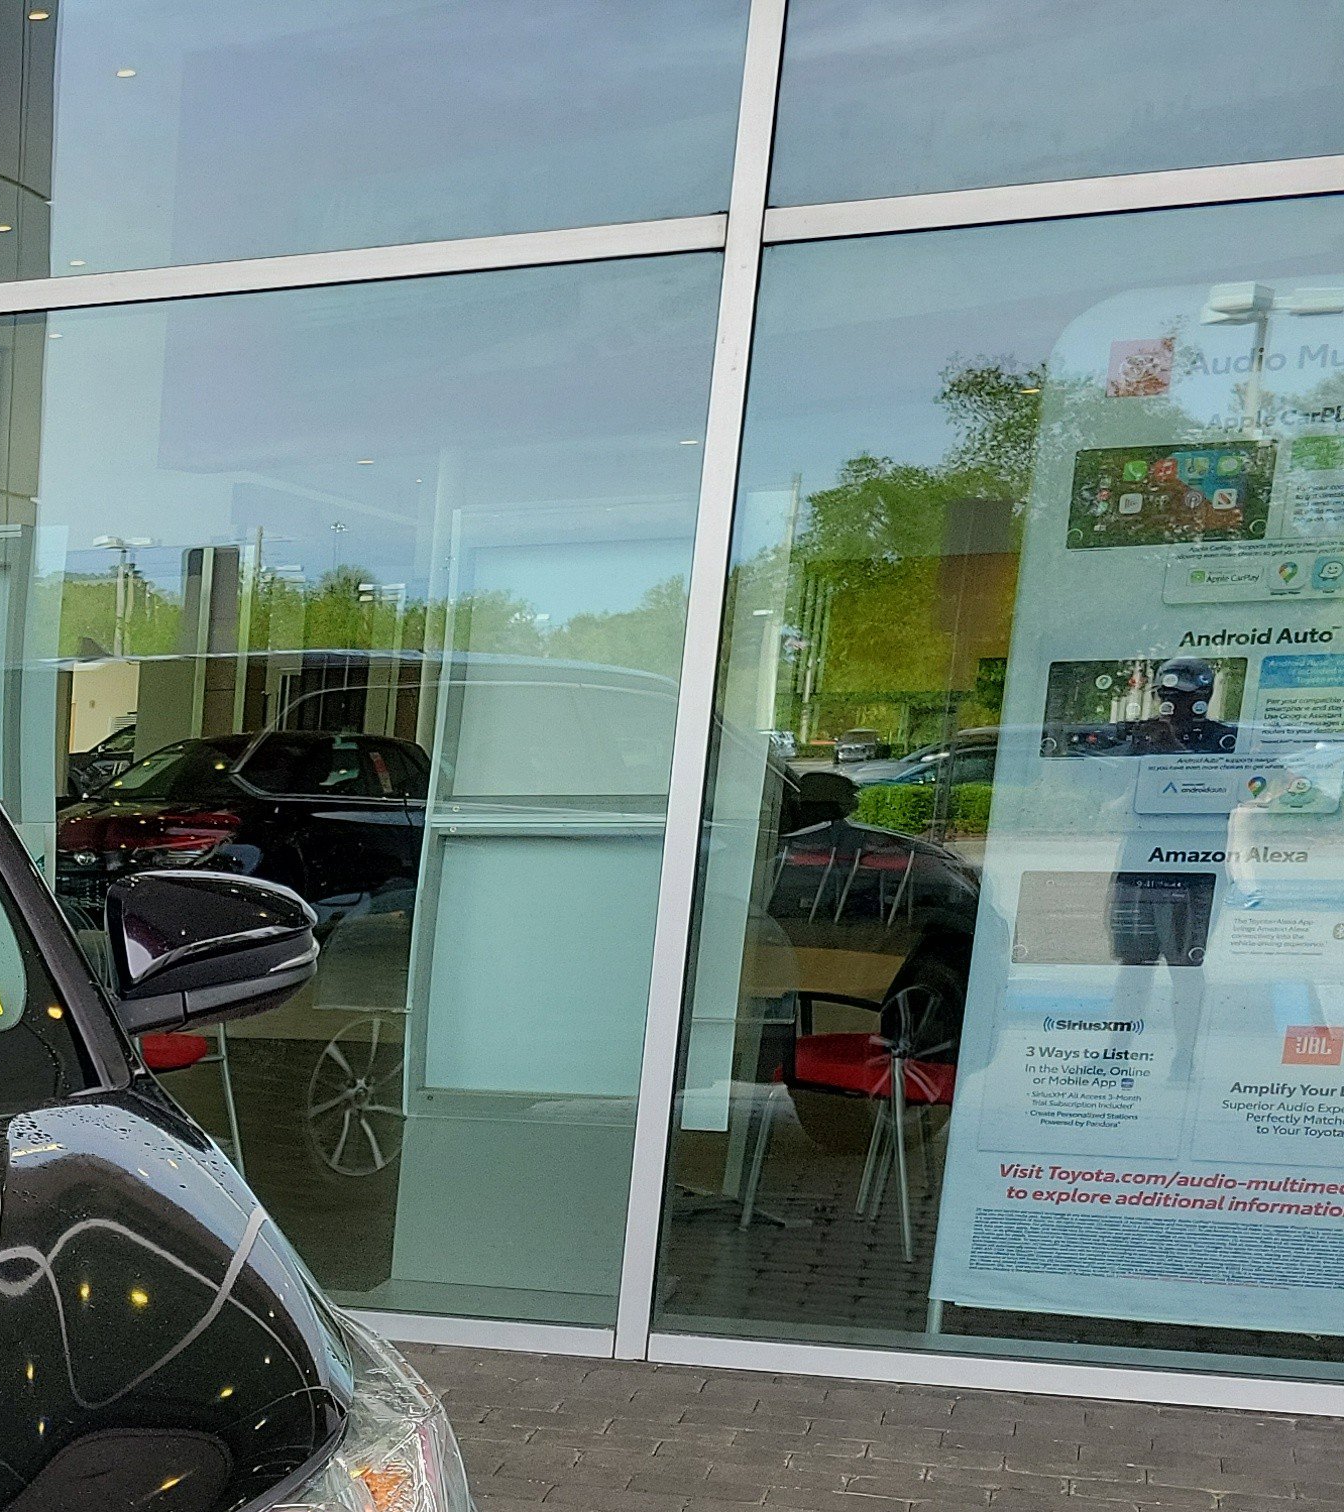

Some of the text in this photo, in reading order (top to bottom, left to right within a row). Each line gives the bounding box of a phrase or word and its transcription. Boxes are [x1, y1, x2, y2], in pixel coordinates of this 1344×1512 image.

[1190, 347, 1287, 375] Audio
[1207, 410, 1275, 433] Apple
[1178, 628, 1273, 647] Android
[1148, 847, 1309, 863] Amazon Alexa
[1025, 1046, 1154, 1061] 3 Ways to Listen:
[1025, 1063, 1151, 1077] In the Vehicle, Online
[1048, 1075, 1090, 1087] Mobile
[1091, 1077, 1117, 1090] App
[1230, 1081, 1296, 1098] Amplify
[1300, 1084, 1337, 1097] Your
[1049, 1100, 1097, 1109] Subscription
[1080, 1093, 1106, 1101] Access
[1221, 1100, 1275, 1112] Superior
[1277, 1101, 1315, 1113] Audio
[1030, 1109, 1138, 1120] Create Personalized Stations
[1246, 1112, 1301, 1126] Perfectly
[1040, 1118, 1074, 1126] Powered
[1075, 1120, 1085, 1128] by
[1256, 1125, 1344, 1139] to Your Toyota
[999, 1163, 1045, 1180] Visit
[1006, 1186, 1344, 1218] to explore additional informatio
